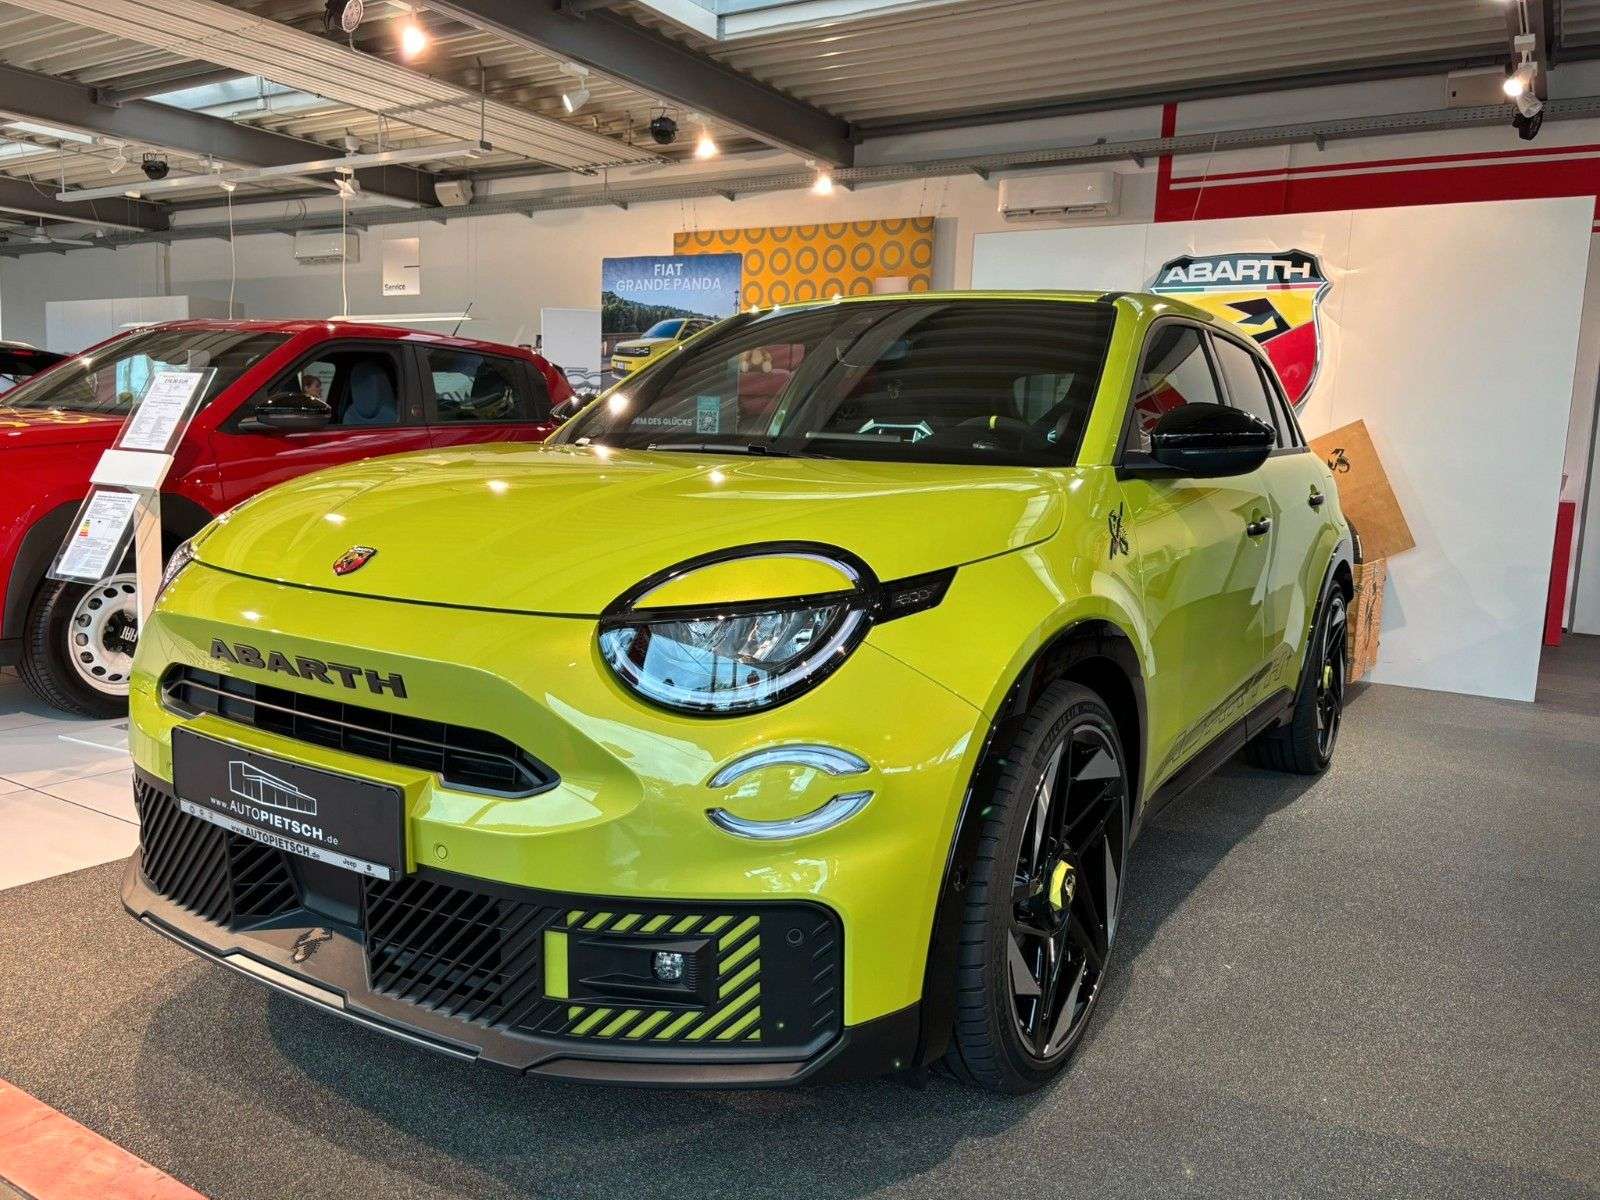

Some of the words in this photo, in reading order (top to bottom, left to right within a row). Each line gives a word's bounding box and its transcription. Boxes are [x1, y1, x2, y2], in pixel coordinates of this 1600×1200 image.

[653, 263, 684, 276] FIAT
[1162, 258, 1312, 284] ABARTH
[615, 279, 671, 292] GRANDE
[673, 277, 722, 291] PANDA
[209, 637, 408, 699] ABARTH
[210, 797, 339, 845] www.AUTOPIETSCH.de
